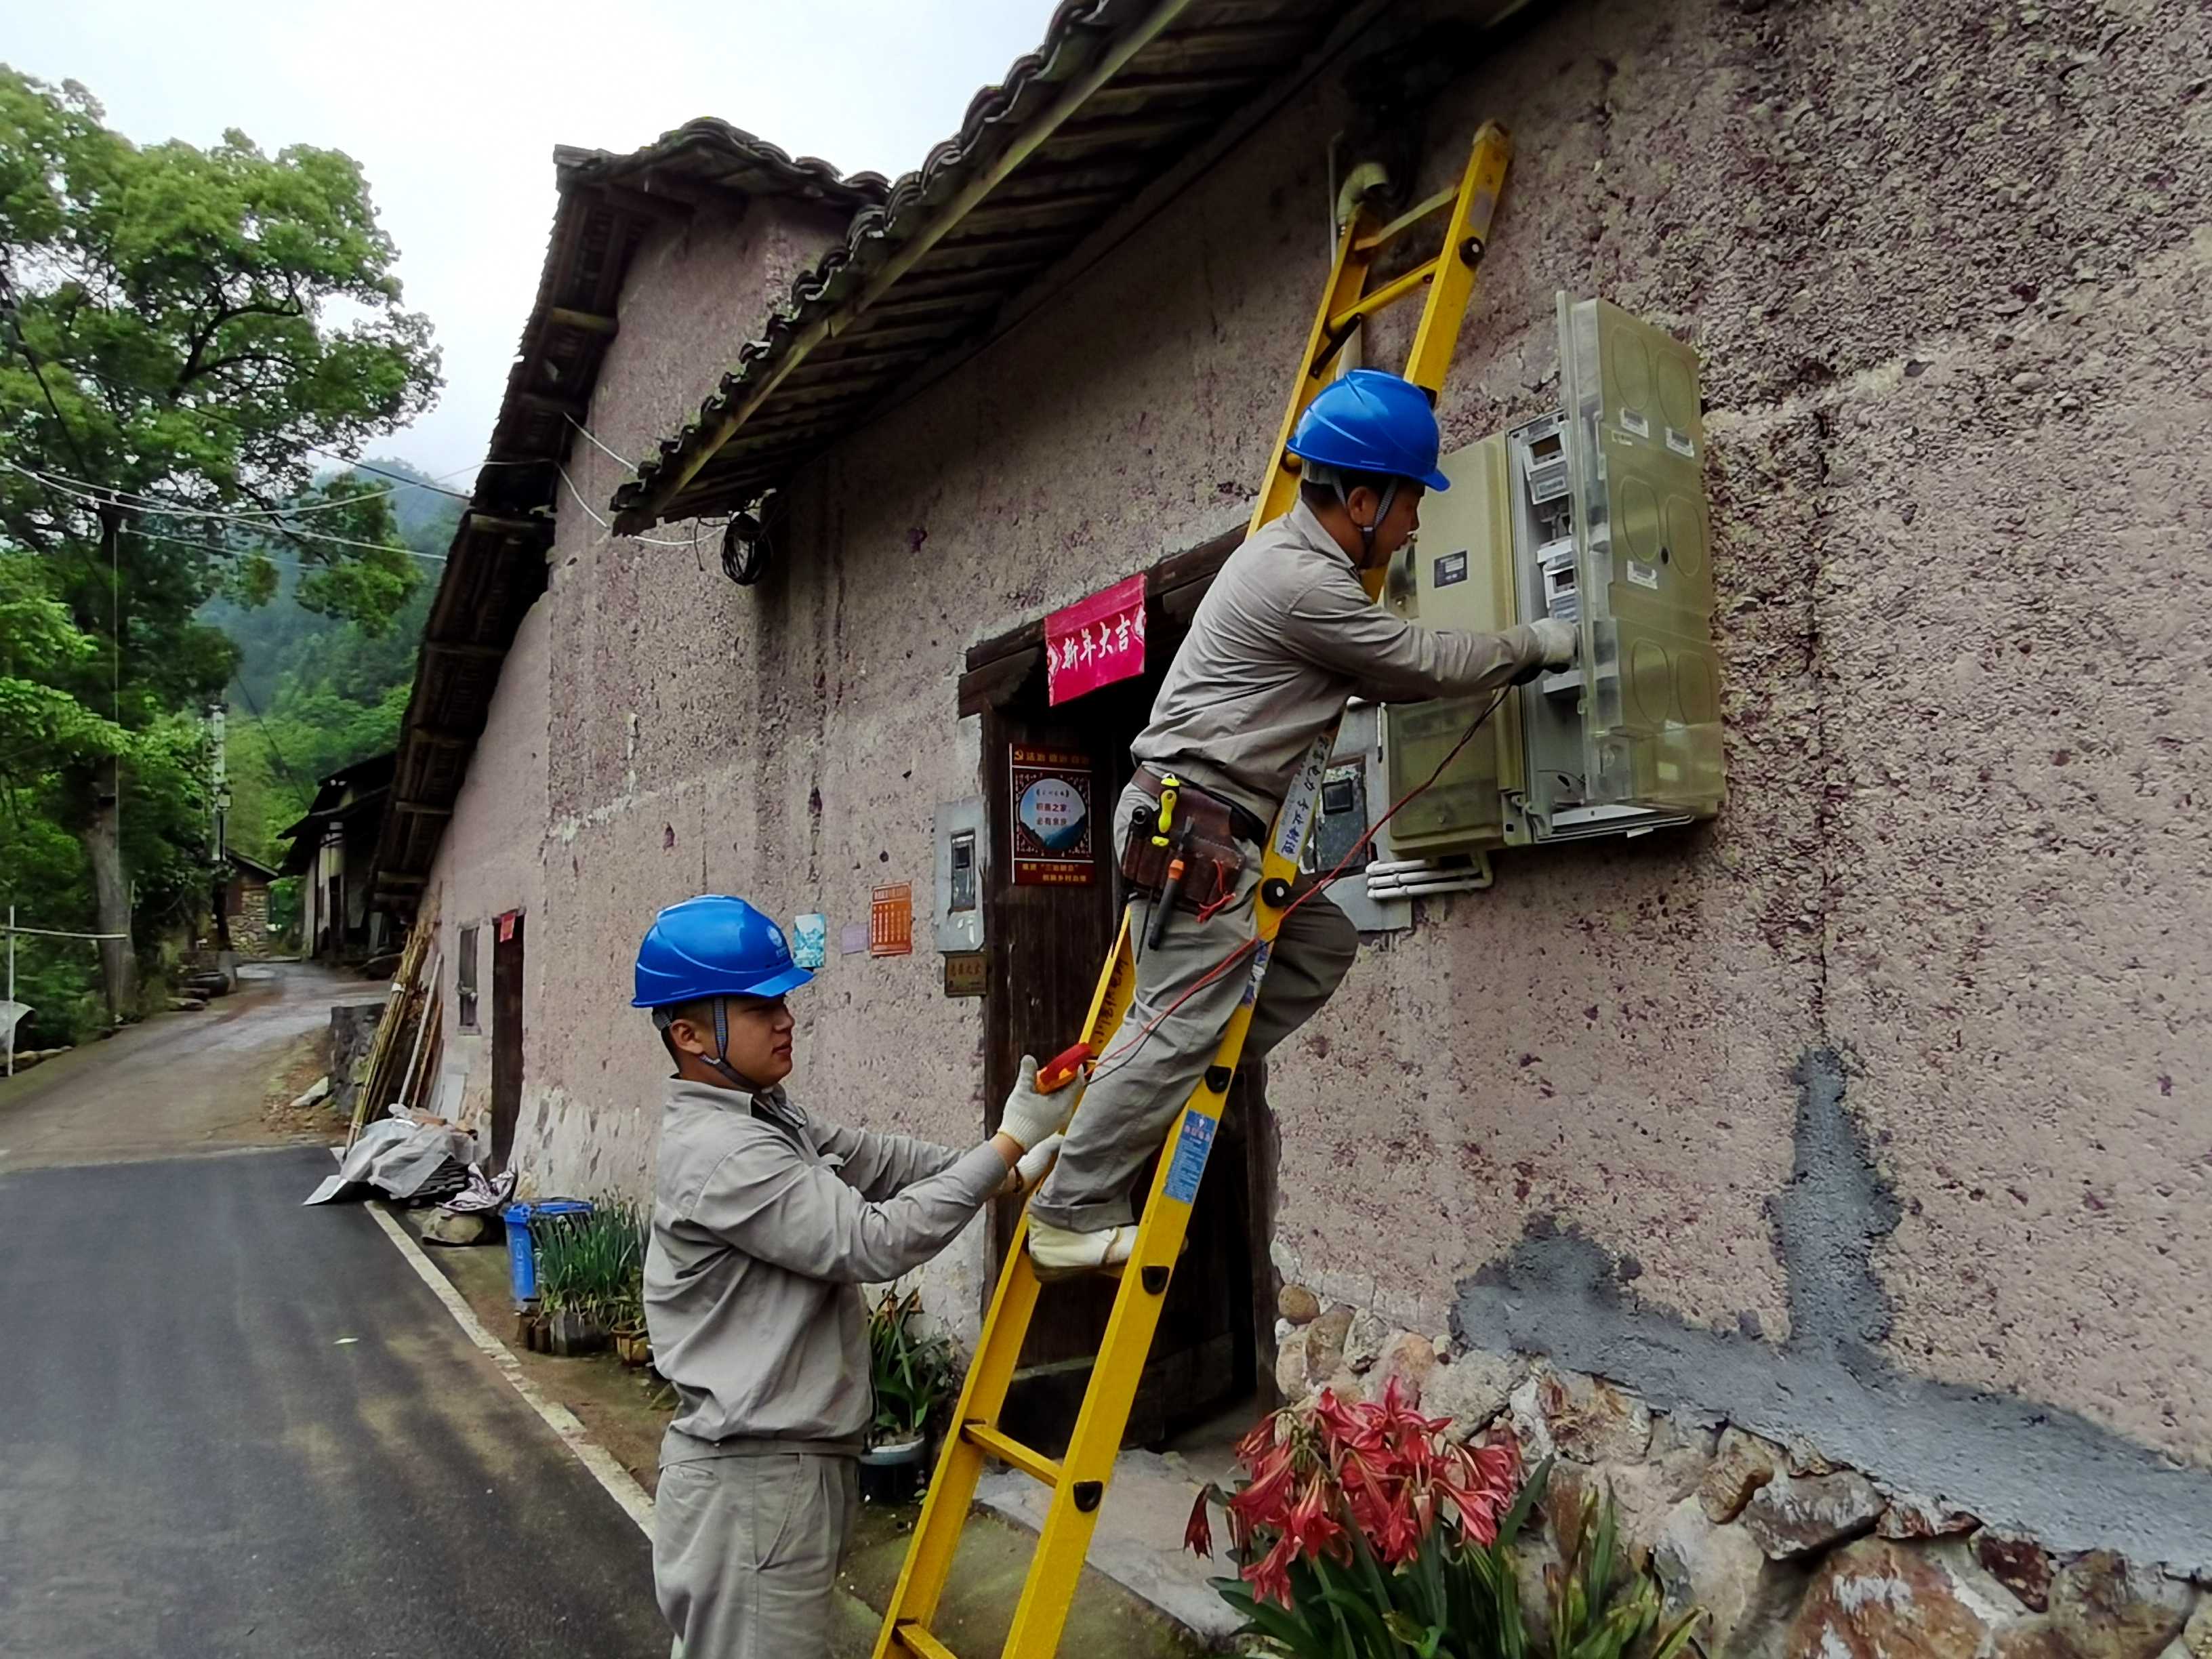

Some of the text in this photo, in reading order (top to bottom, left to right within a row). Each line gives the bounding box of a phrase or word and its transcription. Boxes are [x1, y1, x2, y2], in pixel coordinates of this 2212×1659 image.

[1061, 613, 1131, 672] 新年大吉
[1281, 798, 1310, 855] 专业制造
